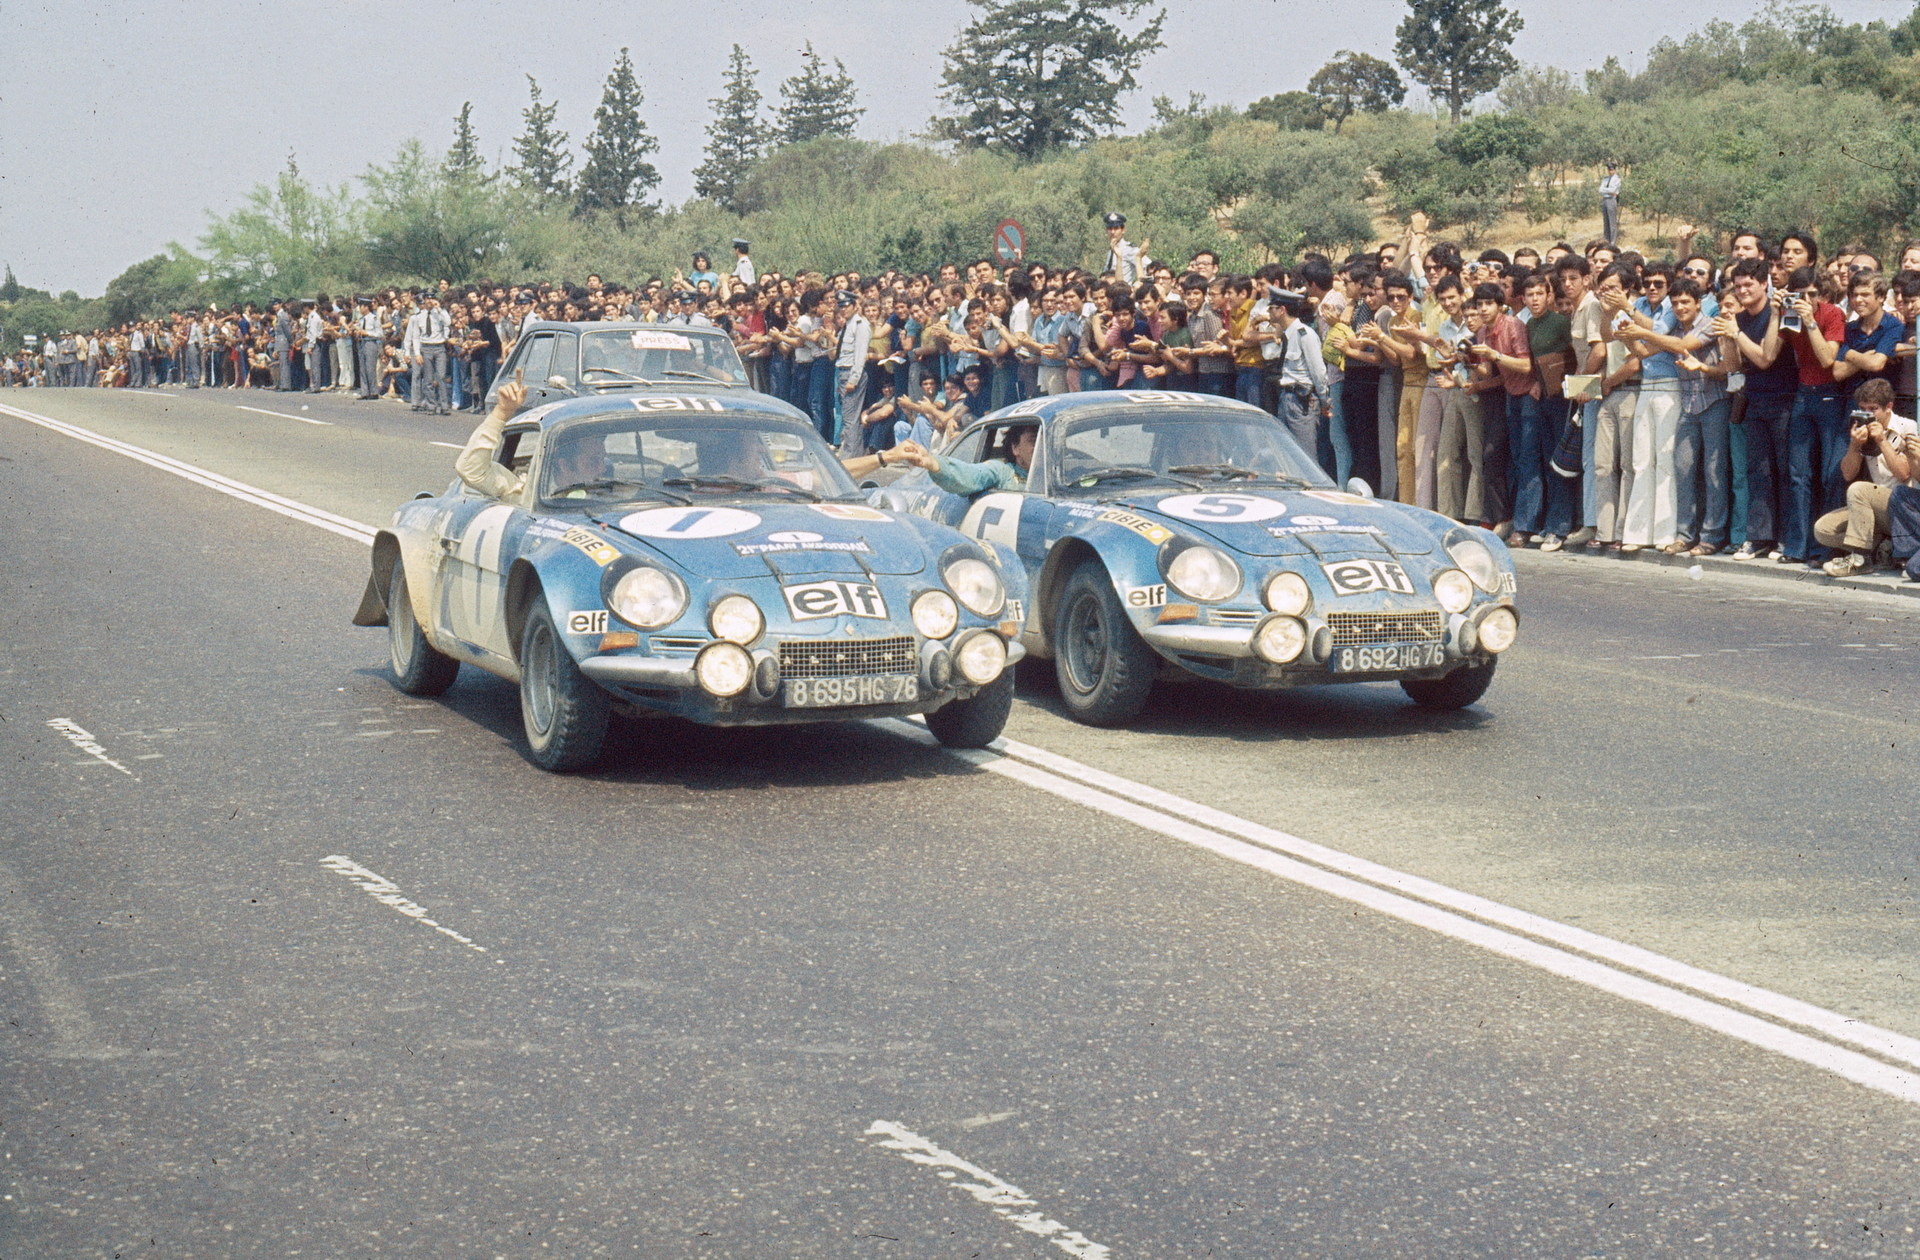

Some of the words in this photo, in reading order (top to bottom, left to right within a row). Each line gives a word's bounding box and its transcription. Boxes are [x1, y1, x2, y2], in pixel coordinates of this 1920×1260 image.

[641, 337, 680, 345] PRESS
[638, 398, 716, 411] elf
[1193, 497, 1256, 517] 5
[666, 510, 714, 533] 1
[1103, 511, 1153, 532] CIBIE
[563, 529, 604, 552] CIBIE
[1333, 562, 1405, 591] elf
[793, 583, 879, 615] elf
[1129, 586, 1165, 606] elf
[570, 612, 606, 632] elf
[1341, 648, 1355, 671] 8
[1358, 646, 1398, 670] 692
[1399, 645, 1421, 668] HG
[1423, 643, 1445, 666] 76
[792, 680, 808, 706] 8
[813, 677, 857, 704] 695
[859, 676, 885, 702] HG
[893, 675, 918, 701] 76
